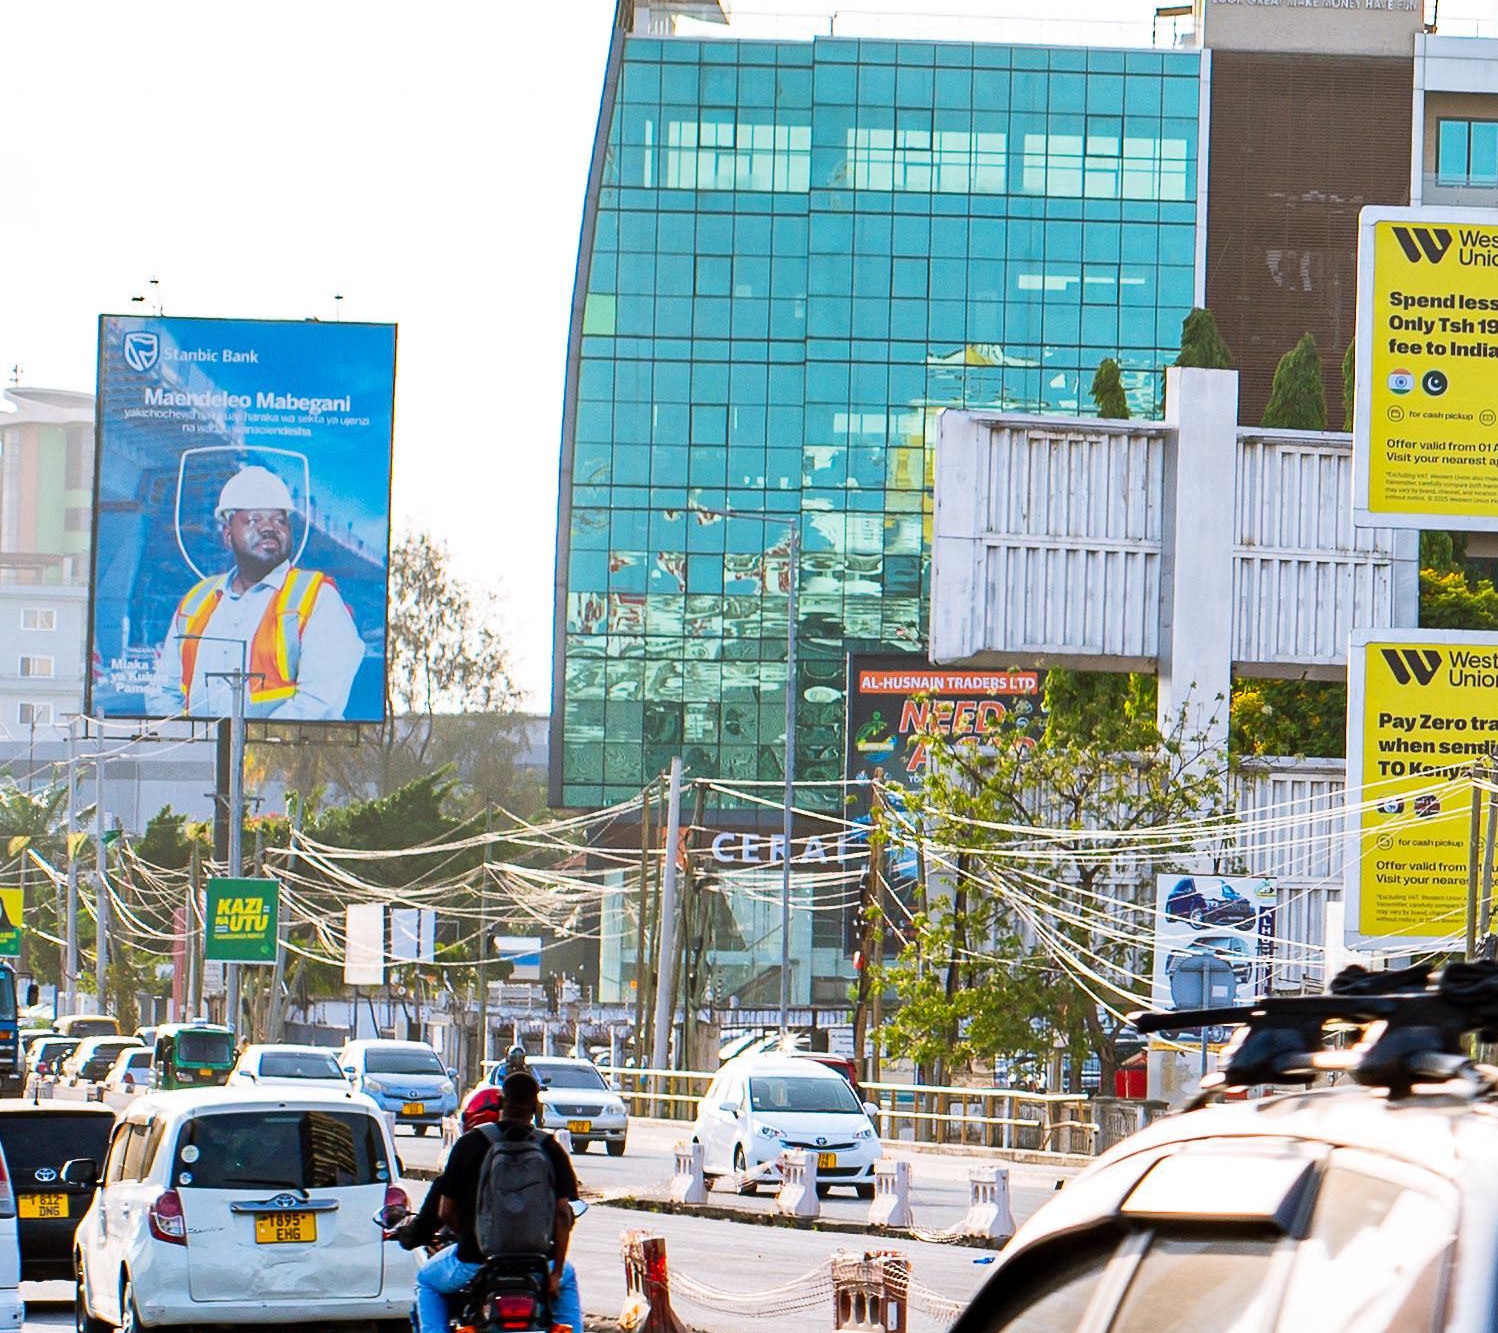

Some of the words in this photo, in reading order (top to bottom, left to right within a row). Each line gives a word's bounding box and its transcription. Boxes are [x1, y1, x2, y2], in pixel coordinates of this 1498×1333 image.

[1389, 291, 1455, 312] Spend
[1389, 314, 1435, 335] Only
[1438, 317, 1475, 333] Tsh
[1389, 338, 1422, 354] fee
[1426, 341, 1446, 355] to
[164, 347, 217, 363] Stanbic
[223, 348, 259, 364] Bank
[144, 388, 251, 408] Maendeleo
[256, 391, 350, 414] Mabegani
[1387, 438, 1417, 449] Offer
[1419, 440, 1446, 451] valid
[1448, 441, 1476, 452] from
[1478, 442, 1491, 453] 01
[1387, 451, 1411, 462] Visit
[1414, 454, 1440, 465] your
[1442, 454, 1486, 465] nearest
[861, 676, 944, 690] AL-HUSNAIN
[947, 676, 1007, 690] TRADERS
[1010, 677, 1036, 690] LTD
[899, 699, 1007, 734] NEED
[1379, 713, 1416, 732] Pay
[1420, 714, 1467, 731] Zero
[1378, 738, 1435, 754] when
[1378, 761, 1405, 777] TO
[217, 897, 263, 915] KAZI
[230, 914, 269, 932] UTU
[276, 1227, 301, 1241] EHG
